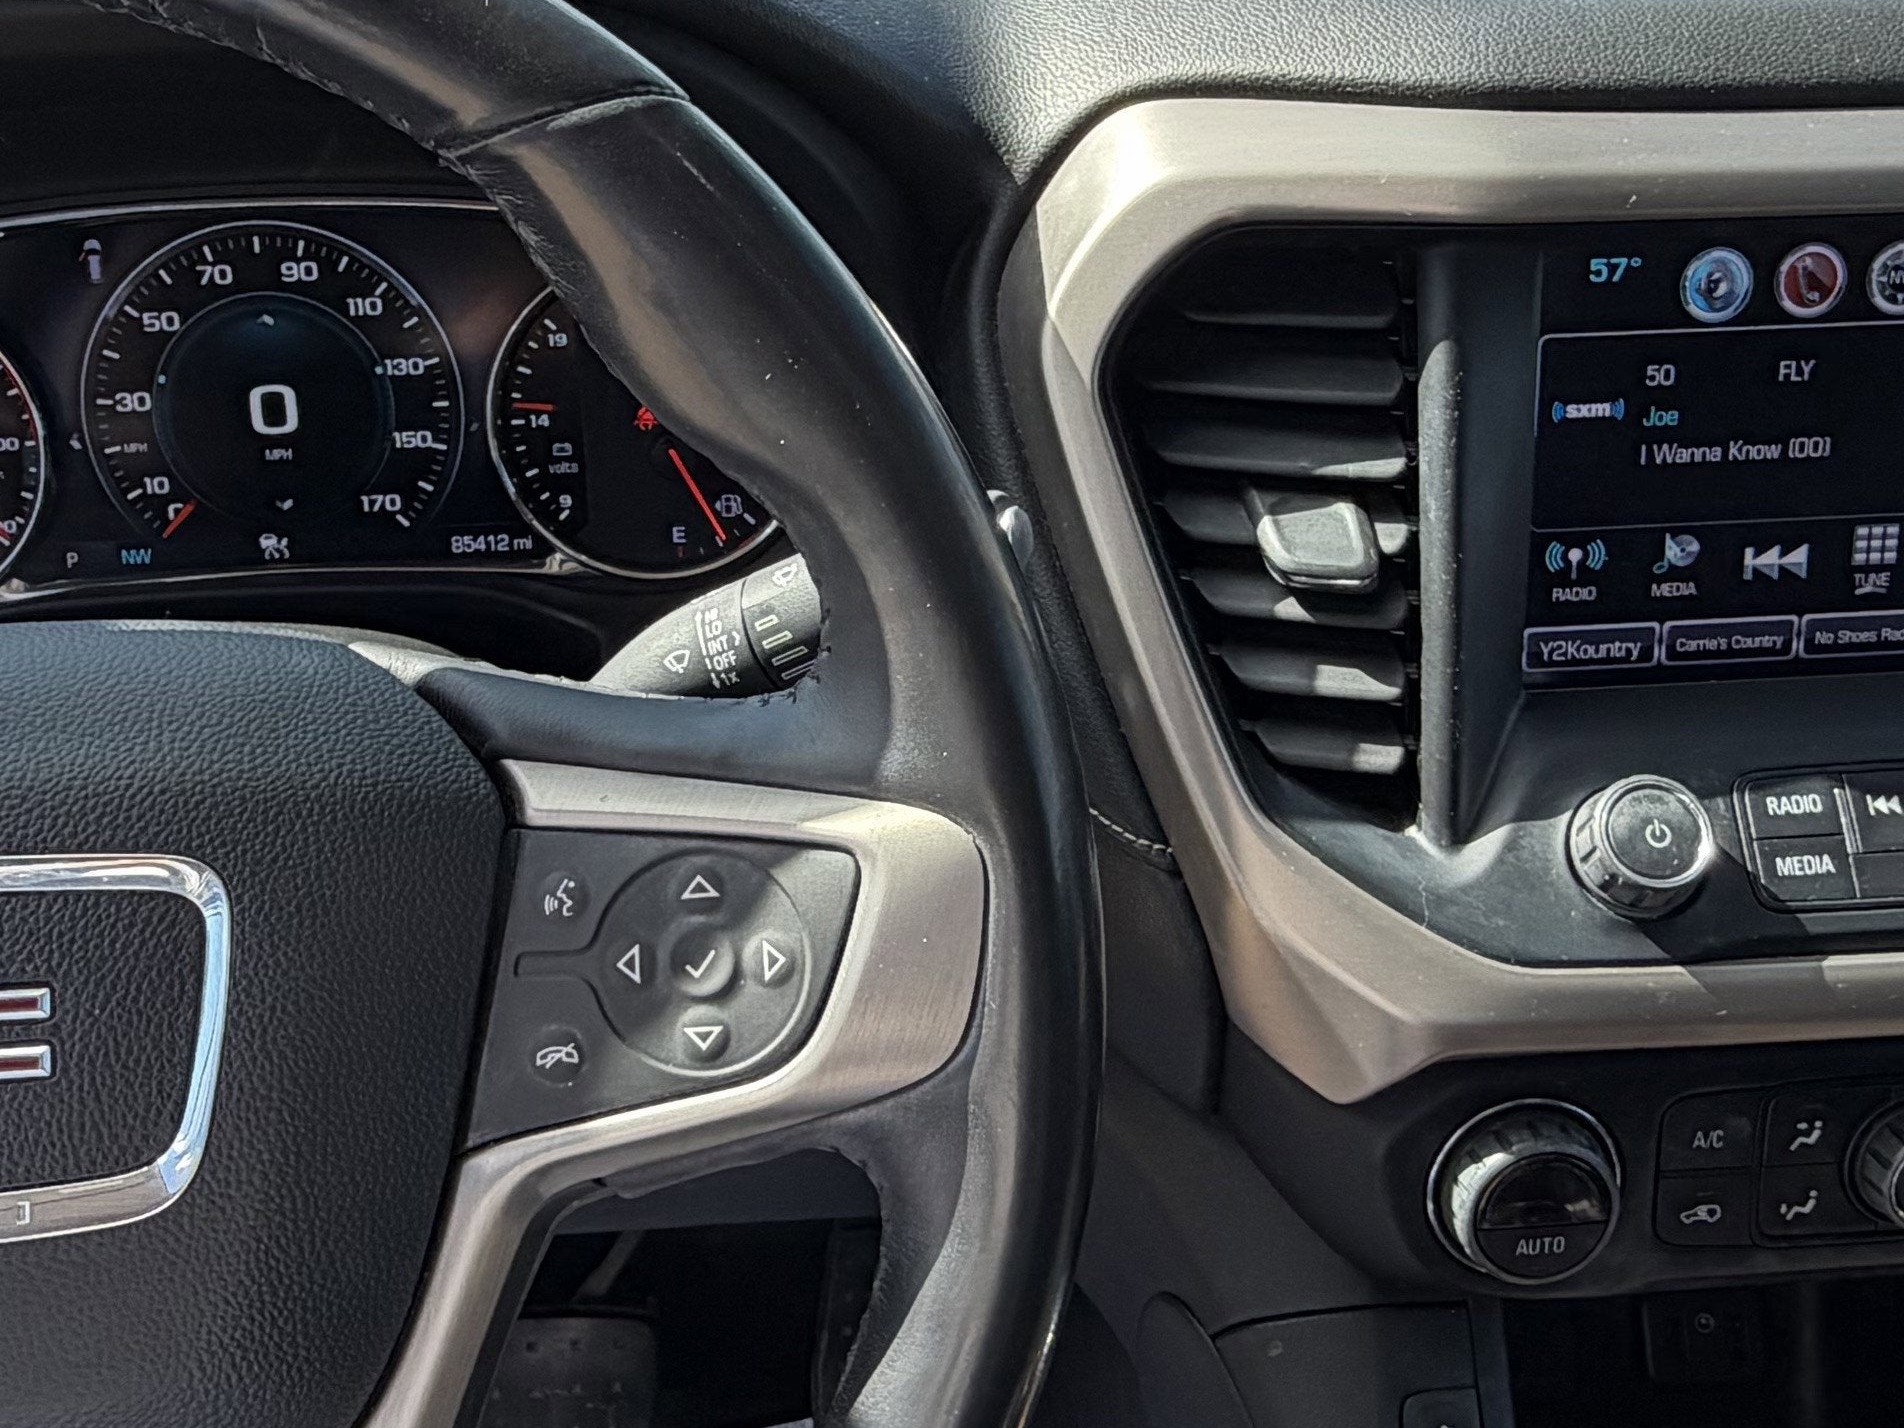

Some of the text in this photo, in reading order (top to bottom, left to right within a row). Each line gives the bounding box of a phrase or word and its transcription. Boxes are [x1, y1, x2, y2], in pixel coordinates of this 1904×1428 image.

[196, 265, 233, 286] 70
[280, 261, 318, 282] 90
[1589, 256, 1643, 284] 57°
[346, 296, 382, 317] 110
[142, 311, 180, 332] 50
[547, 333, 568, 347] 19
[384, 357, 425, 376] 130
[1645, 360, 1816, 387] 50 FLY
[115, 392, 151, 412] 30
[249, 384, 299, 436] 0
[1564, 402, 1612, 419] sxm
[529, 413, 550, 428] 14
[1643, 406, 1679, 427] Joe
[123, 442, 148, 454] MPH
[393, 430, 433, 449] 150
[264, 447, 293, 461] MPH
[1639, 444, 1647, 465] I
[1652, 441, 1722, 465] Wanna
[1728, 439, 1783, 462] Know
[143, 476, 170, 495] 10
[360, 494, 401, 512] 170
[559, 494, 573, 509] 9
[450, 534, 533, 554] 85412 mi
[672, 526, 687, 544] E
[66, 552, 79, 569] P
[121, 548, 152, 566] NW
[1854, 572, 1891, 587] TUNE
[1552, 586, 1597, 603] RADIO
[1651, 582, 1698, 598] MEDIA
[705, 623, 722, 637] LO
[1814, 630, 1834, 646] No
[1837, 627, 1877, 645] Shoes
[707, 635, 730, 655] INT
[1539, 639, 1643, 664] Y2Kountry
[1675, 633, 1785, 653] Carrie's Country
[714, 651, 738, 671] OFF
[1765, 793, 1824, 817] RADIO
[1775, 854, 1837, 877] MEDIA
[1692, 1129, 1725, 1150] A/C
[1515, 1235, 1567, 1257] AUTO
